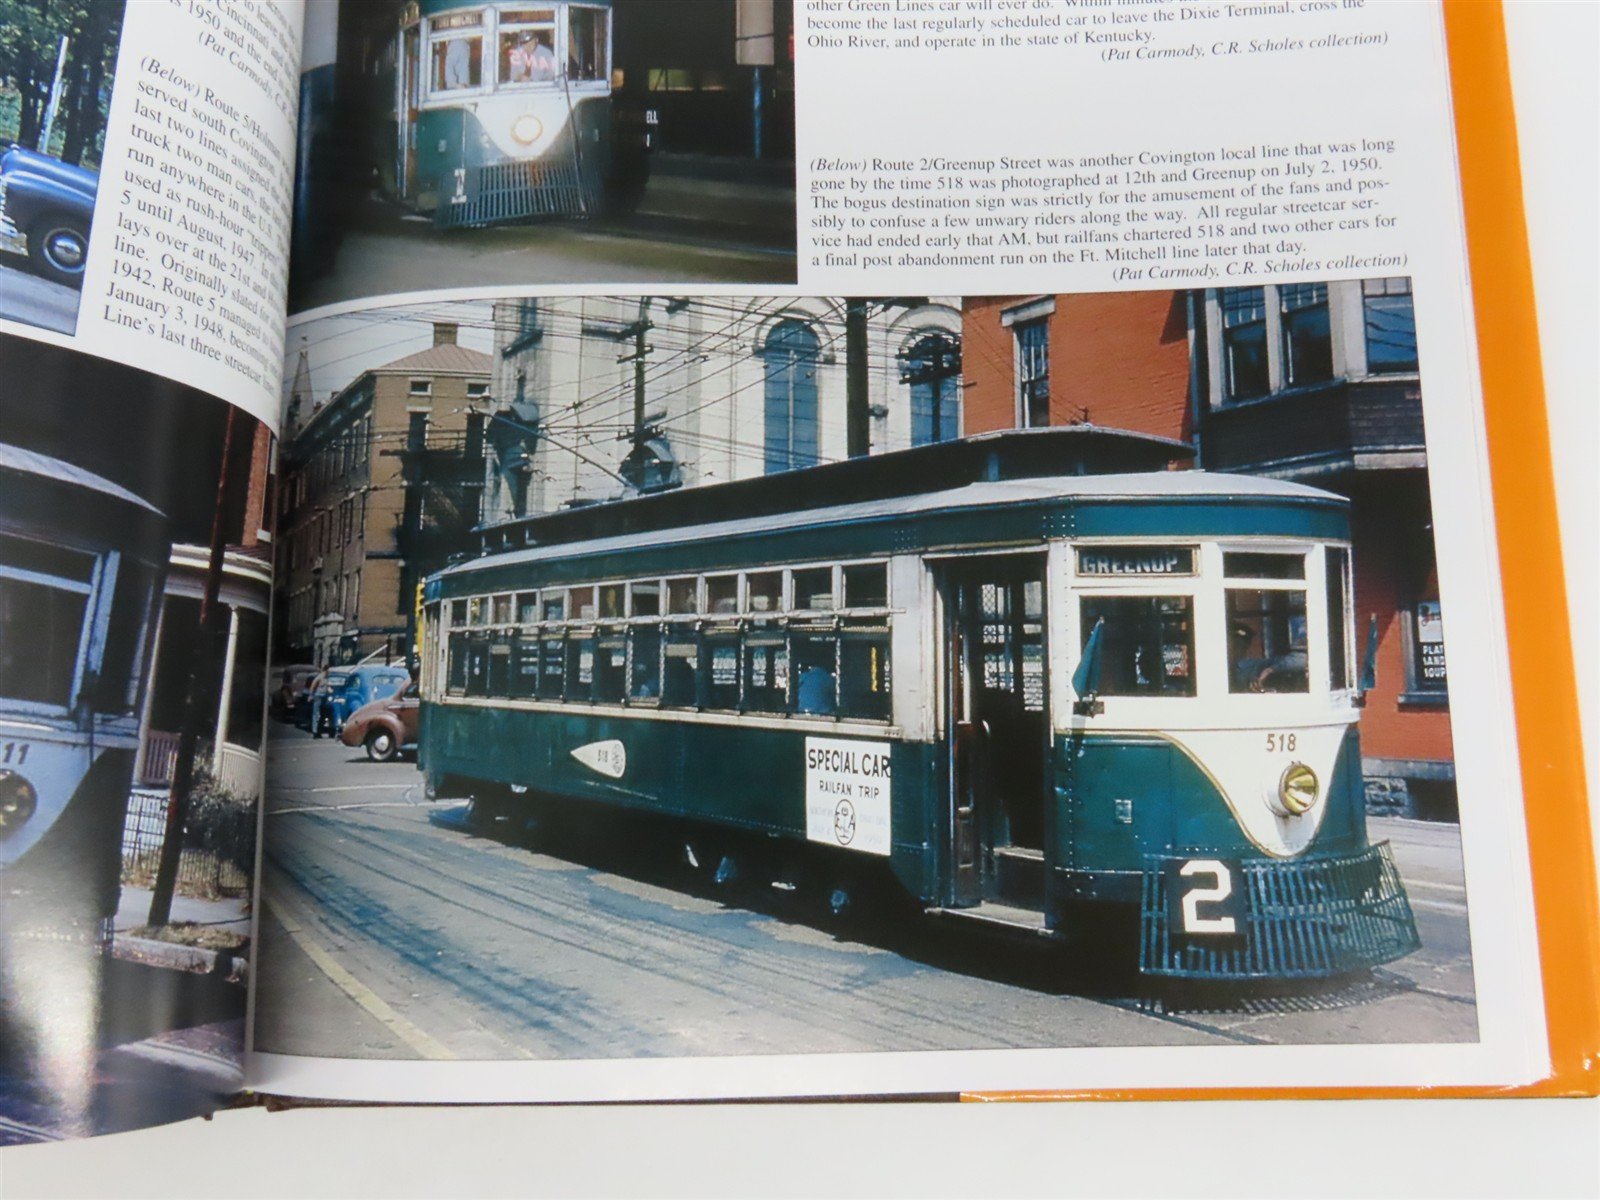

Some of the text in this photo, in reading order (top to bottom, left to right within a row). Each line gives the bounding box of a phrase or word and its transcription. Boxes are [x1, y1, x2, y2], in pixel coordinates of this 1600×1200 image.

[188, 0, 220, 30] 1950
[199, 31, 226, 56] (Pat
[807, 30, 1156, 51] Ohio River, and operate in the state of Kentucky.
[1101, 33, 1388, 62] (Pat Carmody, C.R. Scholes collection)
[140, 56, 200, 97] (Below)
[205, 88, 240, 121] Route
[138, 81, 226, 136] served south
[131, 124, 203, 166] truck two
[135, 98, 228, 159] last two lines
[810, 138, 1395, 174] (Below) Route 2/Greenup Street was another Covington local line that was long
[128, 148, 225, 203] run anywhere
[810, 157, 1382, 194] gone by the time 518 was photographed at 12th and Greenup on July 2, 1950.
[125, 170, 245, 237] used as rush-hour
[810, 177, 1389, 213] The bogus destination sign was strictly for the amusement of the fans and pos-
[120, 189, 131, 205] 5
[138, 199, 173, 223] until
[177, 214, 226, 251] August,
[811, 199, 1379, 232] sibly to confuse a few unwary riders along the way. All regular streetcar ser-
[811, 214, 1397, 250] vice had ended early that AM, but railfans chartered 518 and two other cars for
[118, 211, 204, 261] lays over at
[114, 235, 229, 298] line. Originally
[811, 239, 1306, 270] a final post abandonment run on the Ft. Mitchell line later that day.
[1112, 255, 1408, 281] (Pat Carmody, C.R. Scholes collection)
[113, 259, 204, 307] 1942, Route
[106, 282, 226, 341] January 3, 1948,
[161, 323, 185, 346] last
[190, 336, 222, 361] three
[1082, 555, 1179, 574] GREENUP
[1265, 733, 1298, 754] 518
[808, 748, 892, 779] SPECIAL CAR
[819, 780, 880, 799] RAILFAN TRIP
[1179, 859, 1237, 935] 2
